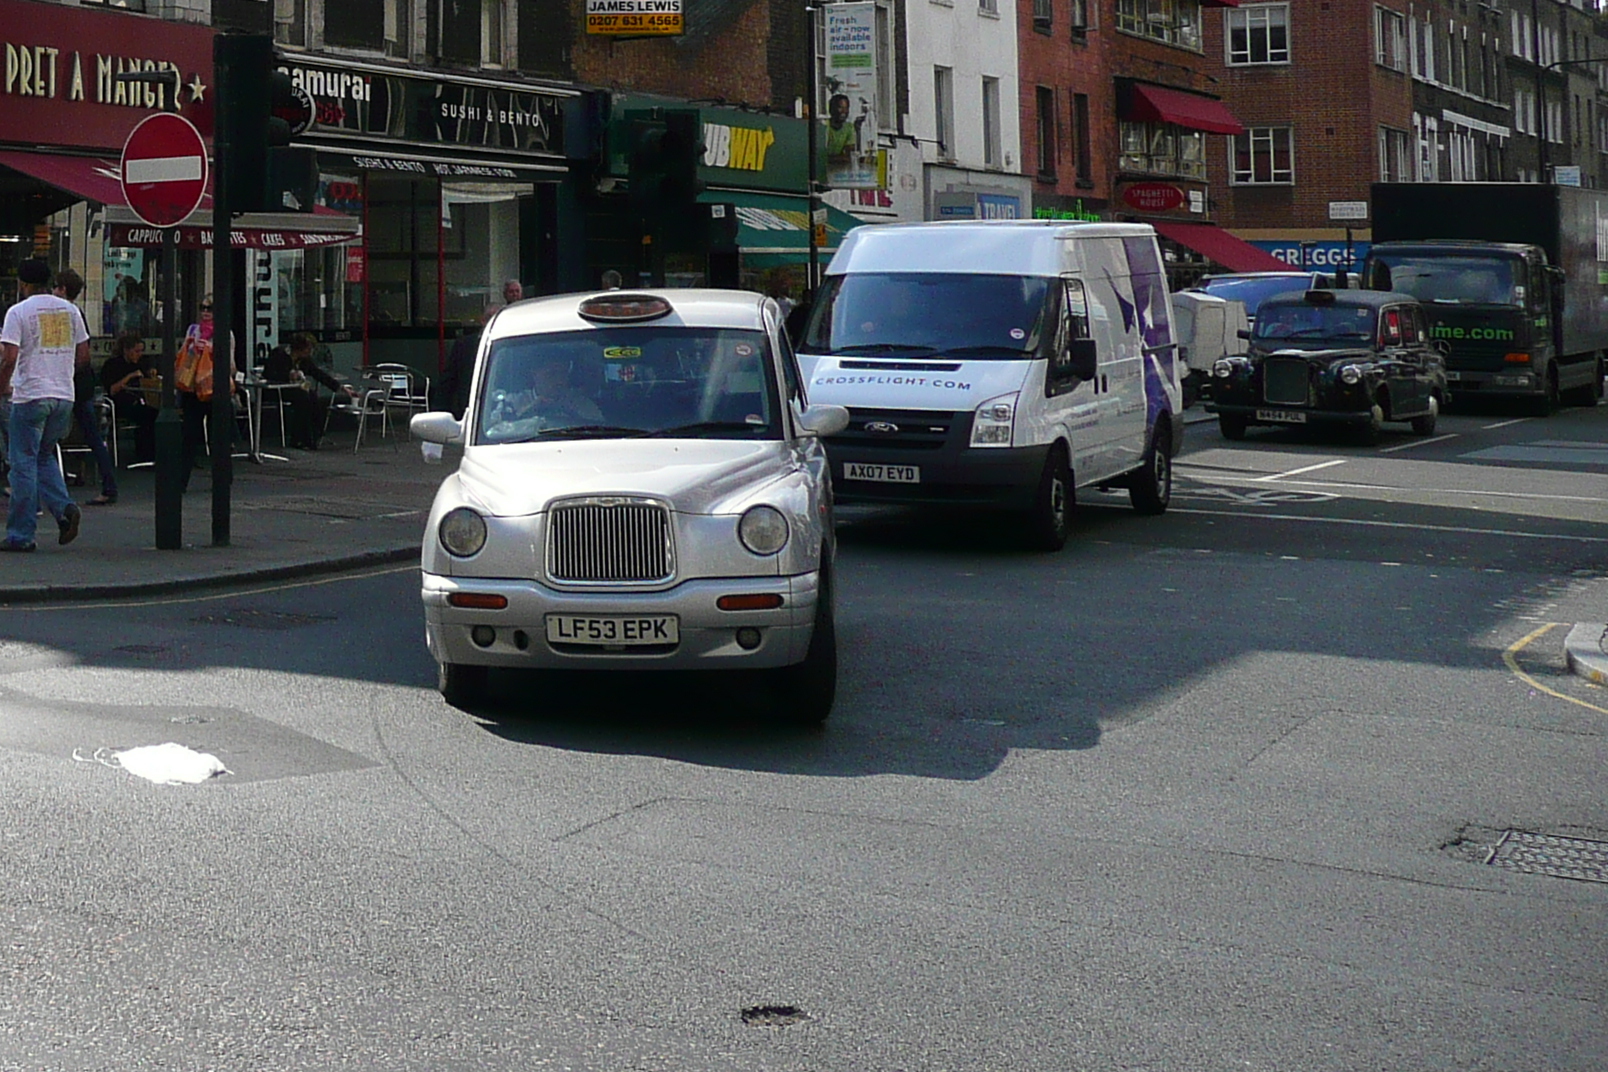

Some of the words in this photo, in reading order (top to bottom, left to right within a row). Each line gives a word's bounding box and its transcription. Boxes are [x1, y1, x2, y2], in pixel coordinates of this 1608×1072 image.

[589, 1, 634, 11] JAMES
[638, 1, 680, 11] LEWIS
[589, 16, 618, 26] 0207
[622, 16, 643, 26] 631
[648, 16, 680, 26] 4565
[829, 16, 857, 25] Fresh
[830, 25, 842, 34] air
[830, 33, 871, 42] available
[829, 43, 866, 51] indoors
[5, 42, 59, 99] PRET
[70, 50, 85, 101] A
[442, 103, 481, 121] SUSHI
[486, 110, 494, 122] &
[500, 110, 540, 127] BENTO
[704, 122, 775, 171] UBWAY
[353, 156, 386, 169] SUSHI
[394, 160, 426, 174] BENTO
[1132, 188, 1174, 198] SPAGHETTI
[1139, 198, 1165, 207] HOUSE
[260, 232, 285, 247] CAKES
[1271, 248, 1356, 265] GREGGS
[1428, 326, 1514, 341] ime.com
[815, 375, 972, 391] CROSSFLIGHT.COM
[850, 465, 884, 479] AX07
[887, 467, 915, 480] EYD
[557, 617, 617, 640] LF53
[622, 618, 668, 640] EPK
